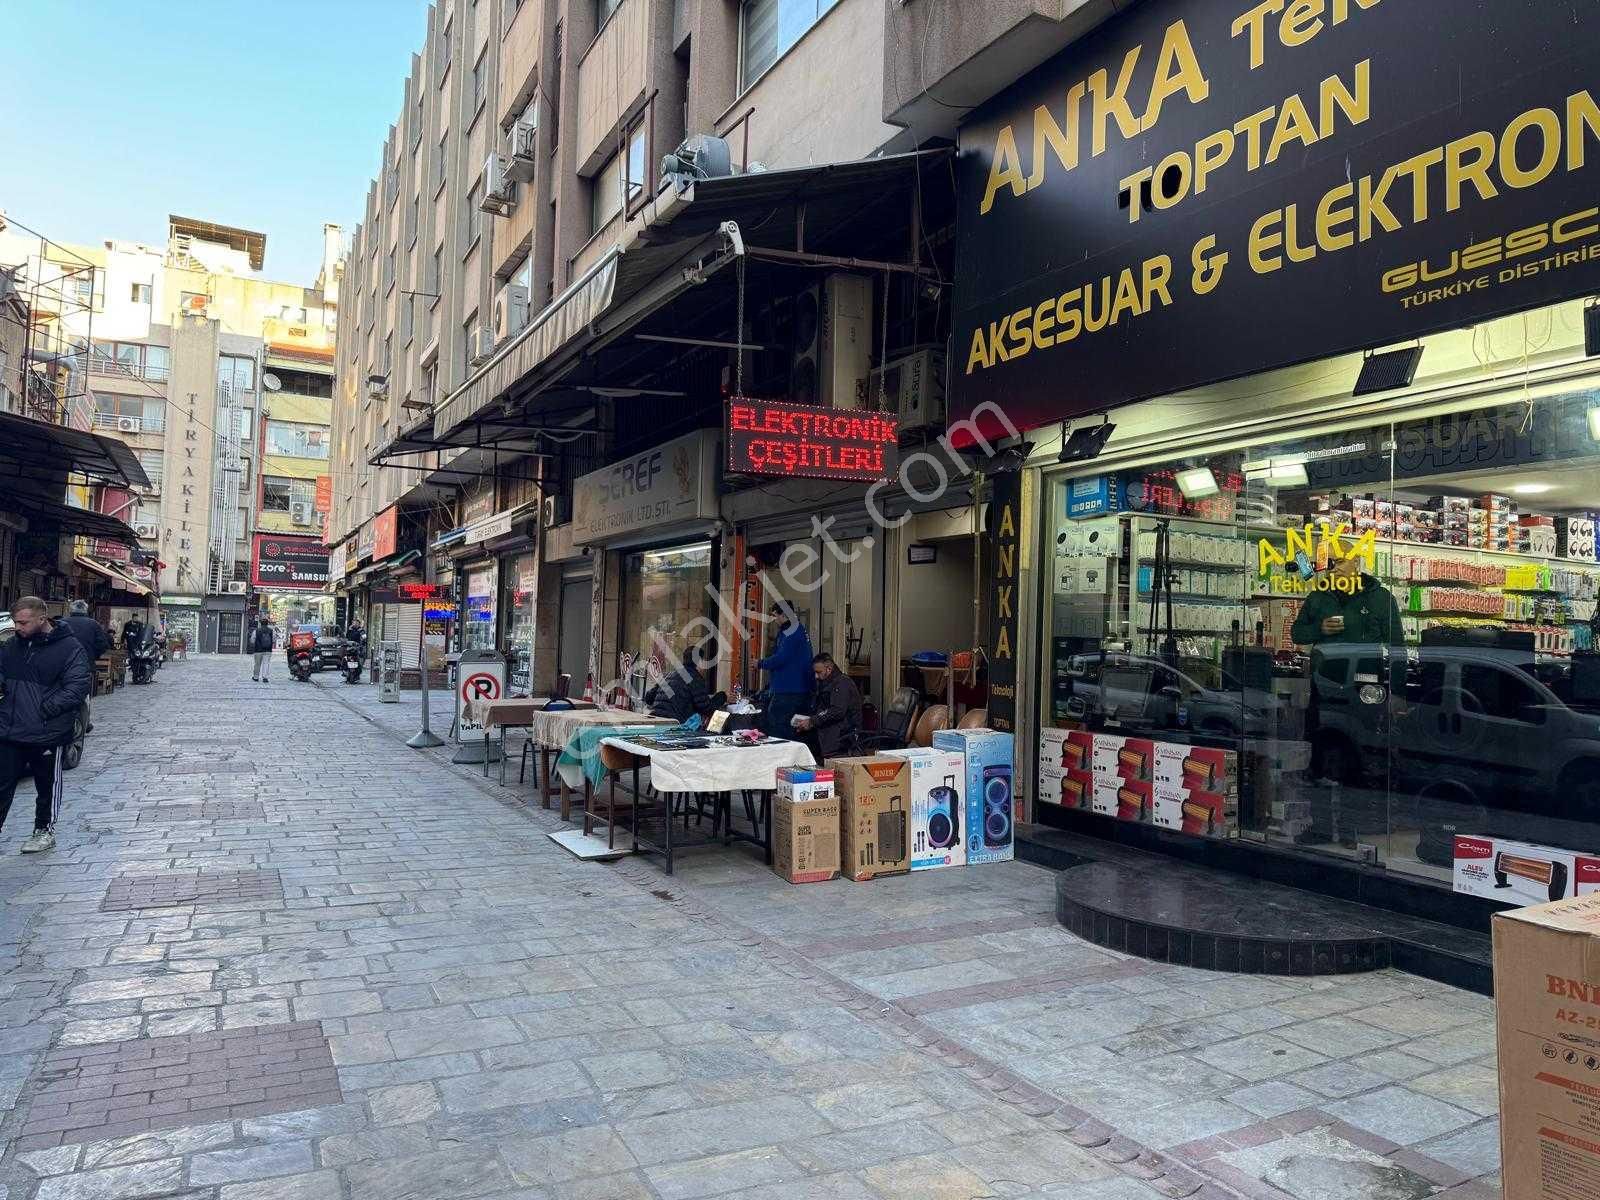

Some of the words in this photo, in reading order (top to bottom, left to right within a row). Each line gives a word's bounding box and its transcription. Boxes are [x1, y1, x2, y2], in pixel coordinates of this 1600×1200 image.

[980, 19, 1210, 216] ANKA
[1121, 58, 1371, 224] TOPTAN
[965, 255, 1173, 375] AKSESUAR
[1191, 233, 1228, 296] &
[1400, 275, 1490, 310] TÜRKİYE
[731, 405, 899, 444] ELEKTRONİK
[748, 438, 883, 473] ÇEŞİTLERİ
[260, 563, 286, 573] zore
[1258, 522, 1377, 577] ANKA
[996, 504, 1015, 660] ANKA
[1269, 572, 1364, 595] Teknoloji
